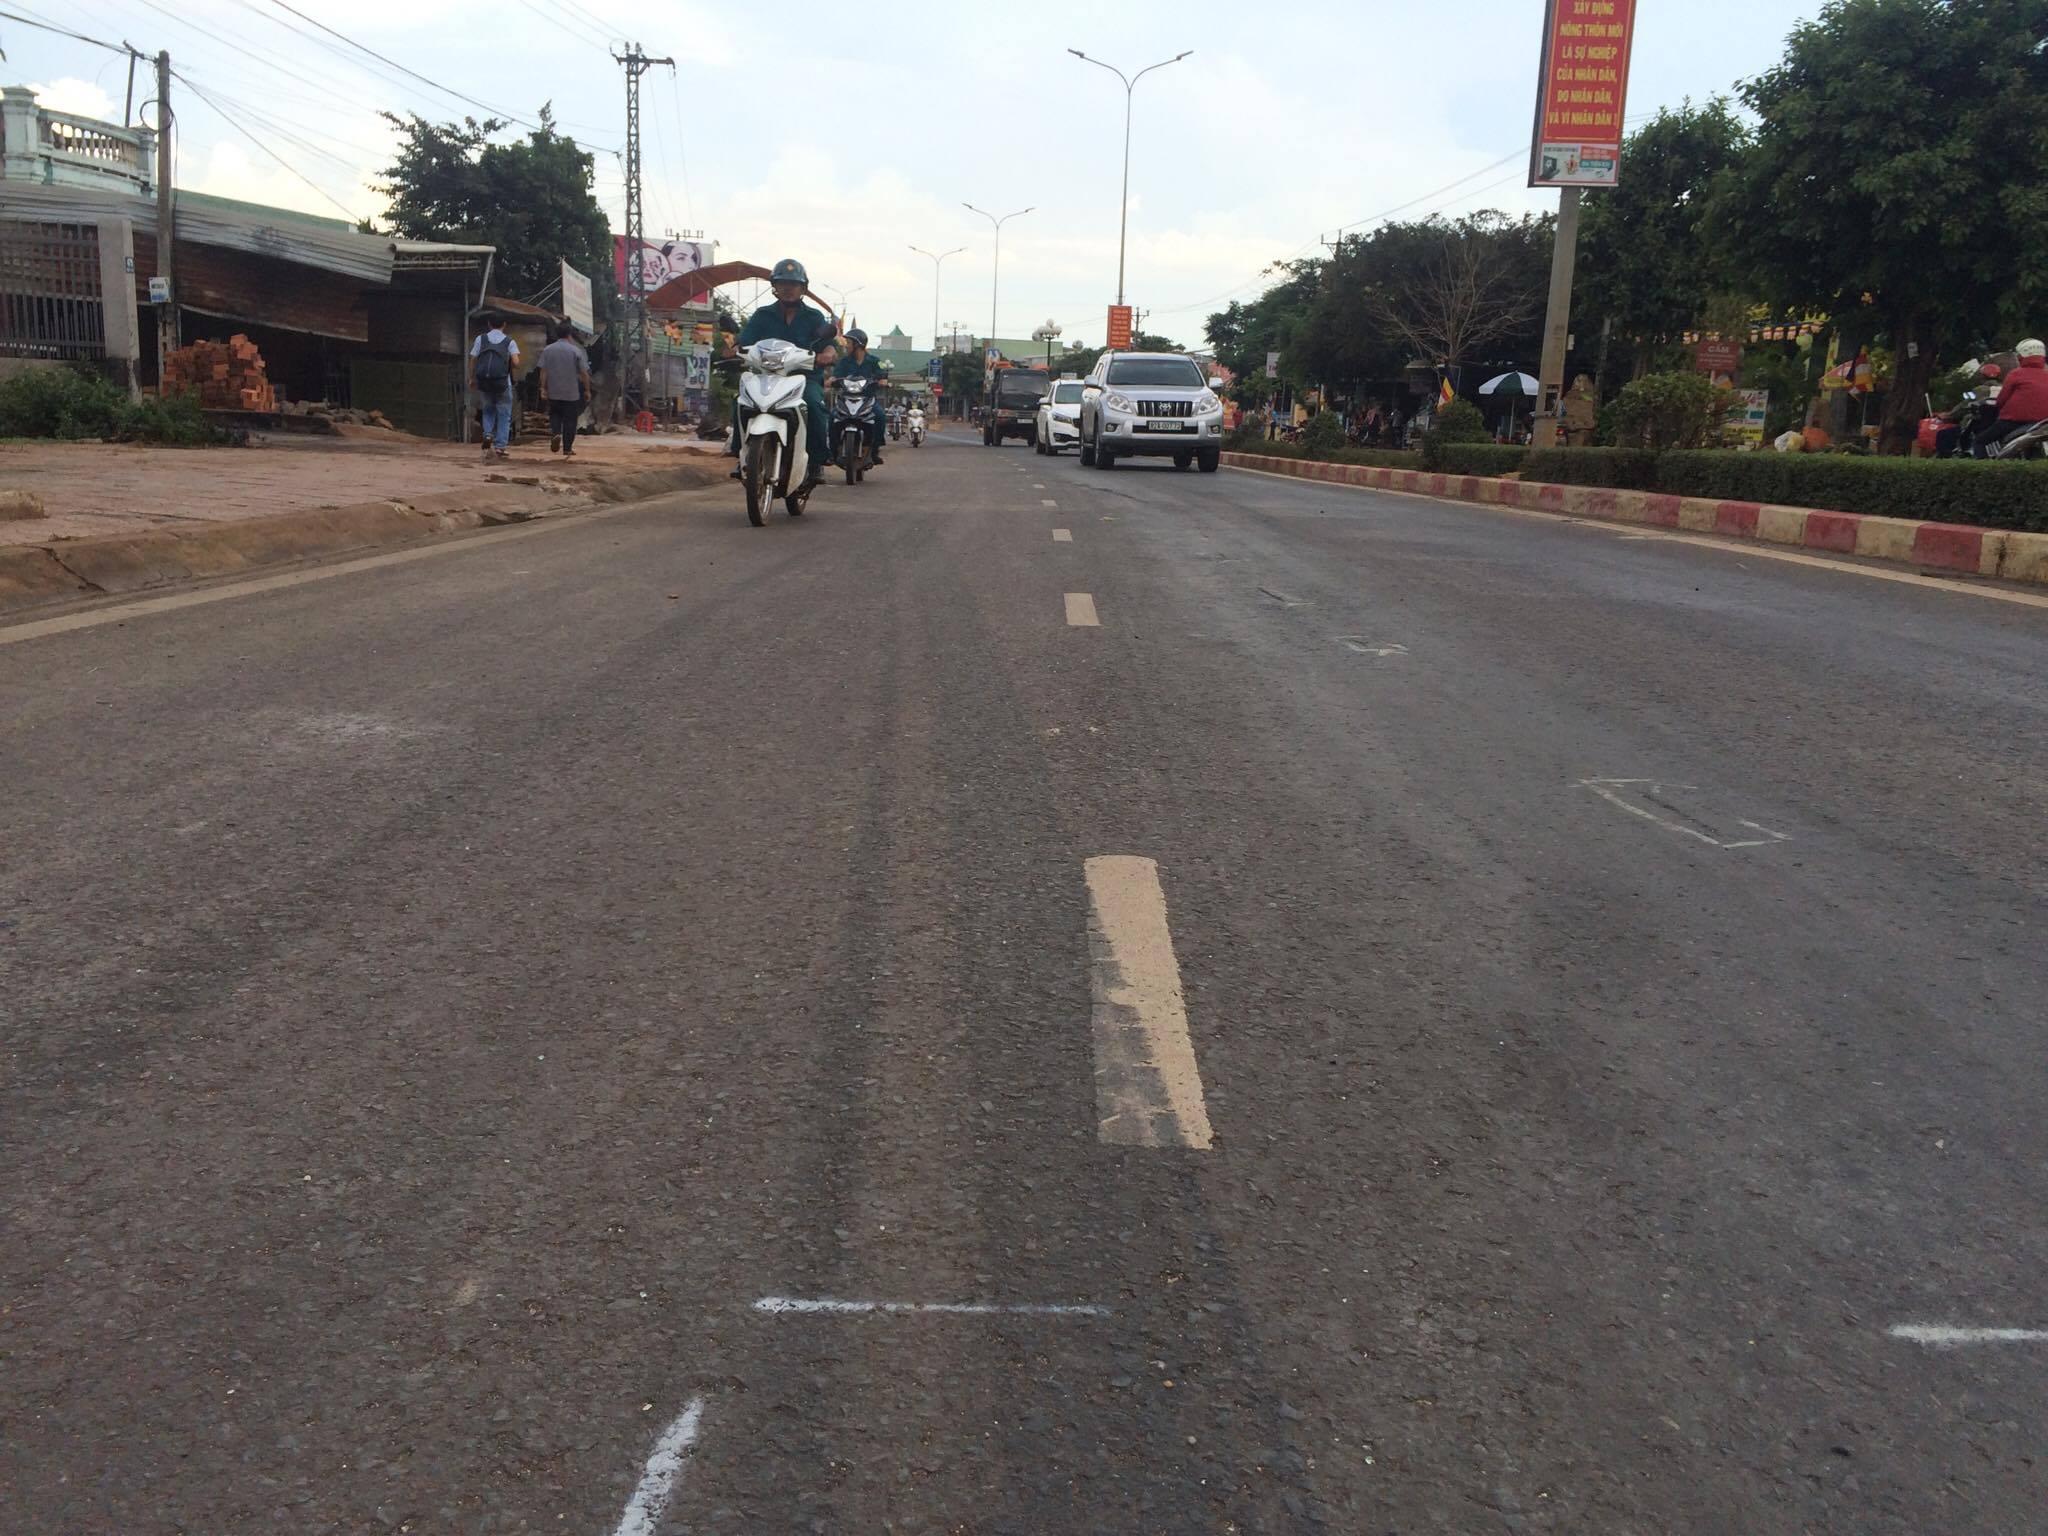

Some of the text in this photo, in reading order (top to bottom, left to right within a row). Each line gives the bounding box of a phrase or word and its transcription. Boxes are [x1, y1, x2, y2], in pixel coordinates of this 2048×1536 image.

[1560, 21, 1583, 37] NÔNG
[1584, 22, 1606, 38] THÔN
[1562, 43, 1617, 61] LÀ SỰ NGHIỆP
[1557, 63, 1573, 80] CỦA
[1574, 65, 1598, 81] NHÂN
[1557, 90, 1569, 103] DO
[1570, 87, 1594, 104] NHÂN
[1549, 109, 1560, 124] VÀ
[1571, 109, 1594, 125] NHÂN
[1594, 110, 1613, 126] DÂN
